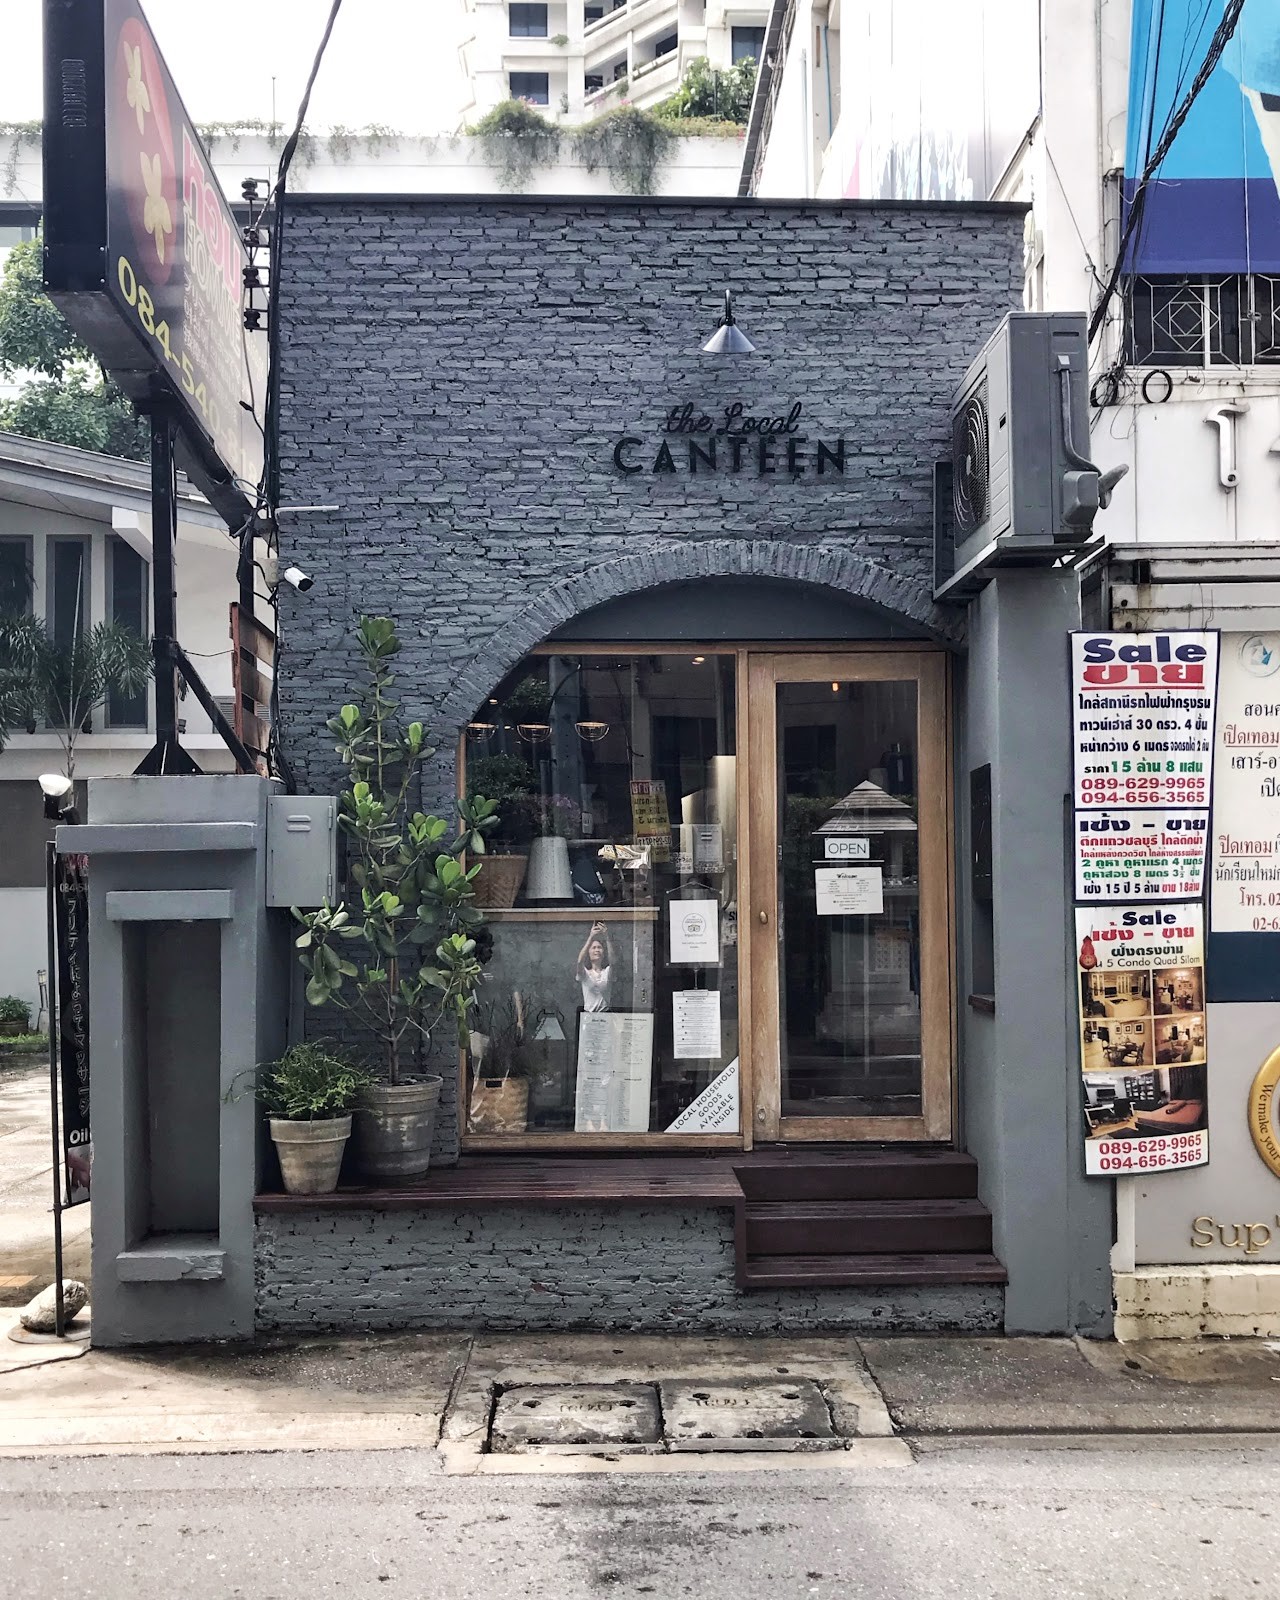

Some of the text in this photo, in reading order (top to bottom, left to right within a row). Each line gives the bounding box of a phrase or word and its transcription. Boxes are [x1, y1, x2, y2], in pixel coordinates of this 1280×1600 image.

[183, 203, 241, 356] HOMME
[117, 255, 258, 483] 084-540-818
[663, 401, 802, 436] the Local
[613, 436, 845, 475] CANTEEN
[1083, 636, 1207, 663] Sale
[1083, 664, 1204, 684] ขาย
[1136, 719, 1153, 731] 30
[1156, 719, 1181, 731] ตรว.
[1184, 719, 1192, 731] 4
[1195, 713, 1208, 731] ชั้น
[1223, 724, 1279, 744] เปิดเทอม
[1132, 740, 1141, 752] 6
[1144, 741, 1169, 752] เมตร
[1196, 740, 1201, 752] 2
[1084, 765, 1109, 774] ราคา
[1136, 756, 1161, 773] ล้าน
[1165, 761, 1175, 773] 8
[1179, 761, 1203, 773] แสน
[1231, 751, 1280, 769] เสาร์-อ
[1081, 777, 1205, 790] 089-629-9965
[1081, 791, 1205, 804] 094-656-3565
[1166, 819, 1206, 831] ขาย
[828, 843, 867, 854] OPEN
[1218, 834, 1272, 854] ปิดเทอม
[1081, 859, 1091, 867] 2
[1172, 858, 1180, 866] 4
[1133, 870, 1141, 878] 8
[1145, 869, 1169, 878] เมตร
[1124, 881, 1131, 894] ปี
[1134, 883, 1141, 894] 5
[1144, 880, 1160, 894] ล้าน
[1239, 886, 1266, 907] โทร.
[1122, 909, 1177, 926] Sale
[1252, 916, 1280, 931] 02-6
[1162, 927, 1195, 939] ขาย
[1107, 958, 1114, 968] 5
[1117, 957, 1151, 968] Condo
[1153, 955, 1178, 966] Quad
[1180, 955, 1201, 965] Silom
[674, 1108, 697, 1130] LOCAL
[695, 1066, 736, 1108] HOUSEHOLD
[698, 1092, 723, 1118] GOODS
[699, 1093, 734, 1130] AVAILABLE
[711, 1104, 735, 1128] INSIDE
[1258, 1084, 1280, 1161] We make your
[69, 1129, 88, 1145] Oil
[1099, 1134, 1202, 1155] 089-629-9965
[1099, 1148, 1202, 1170] 094-656-3565
[1190, 1215, 1272, 1255] Sup
